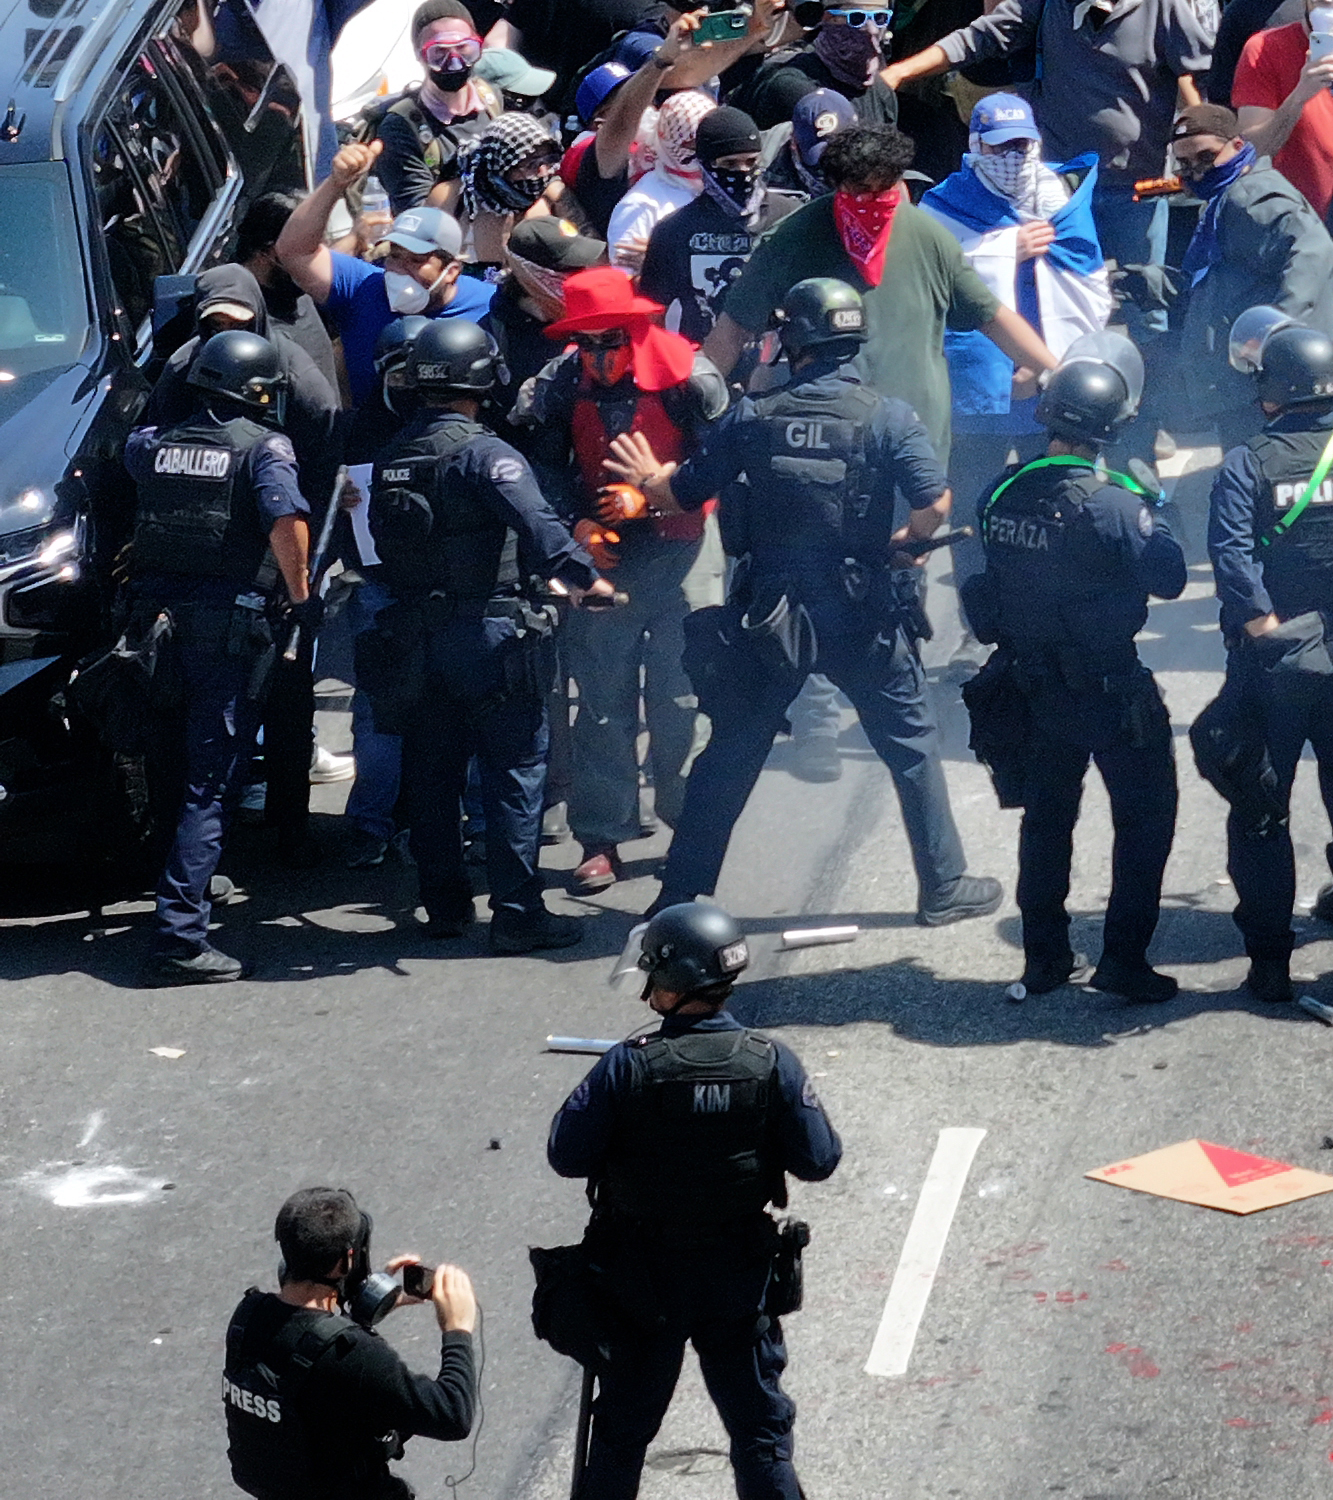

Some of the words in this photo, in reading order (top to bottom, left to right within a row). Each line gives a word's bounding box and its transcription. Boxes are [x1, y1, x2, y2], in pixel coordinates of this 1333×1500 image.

[154, 446, 233, 479] CABALLERO
[383, 468, 411, 482] POLICE
[989, 515, 1049, 551] PERAZA
[693, 1083, 731, 1114] KIM
[222, 1376, 282, 1424] PRESS
